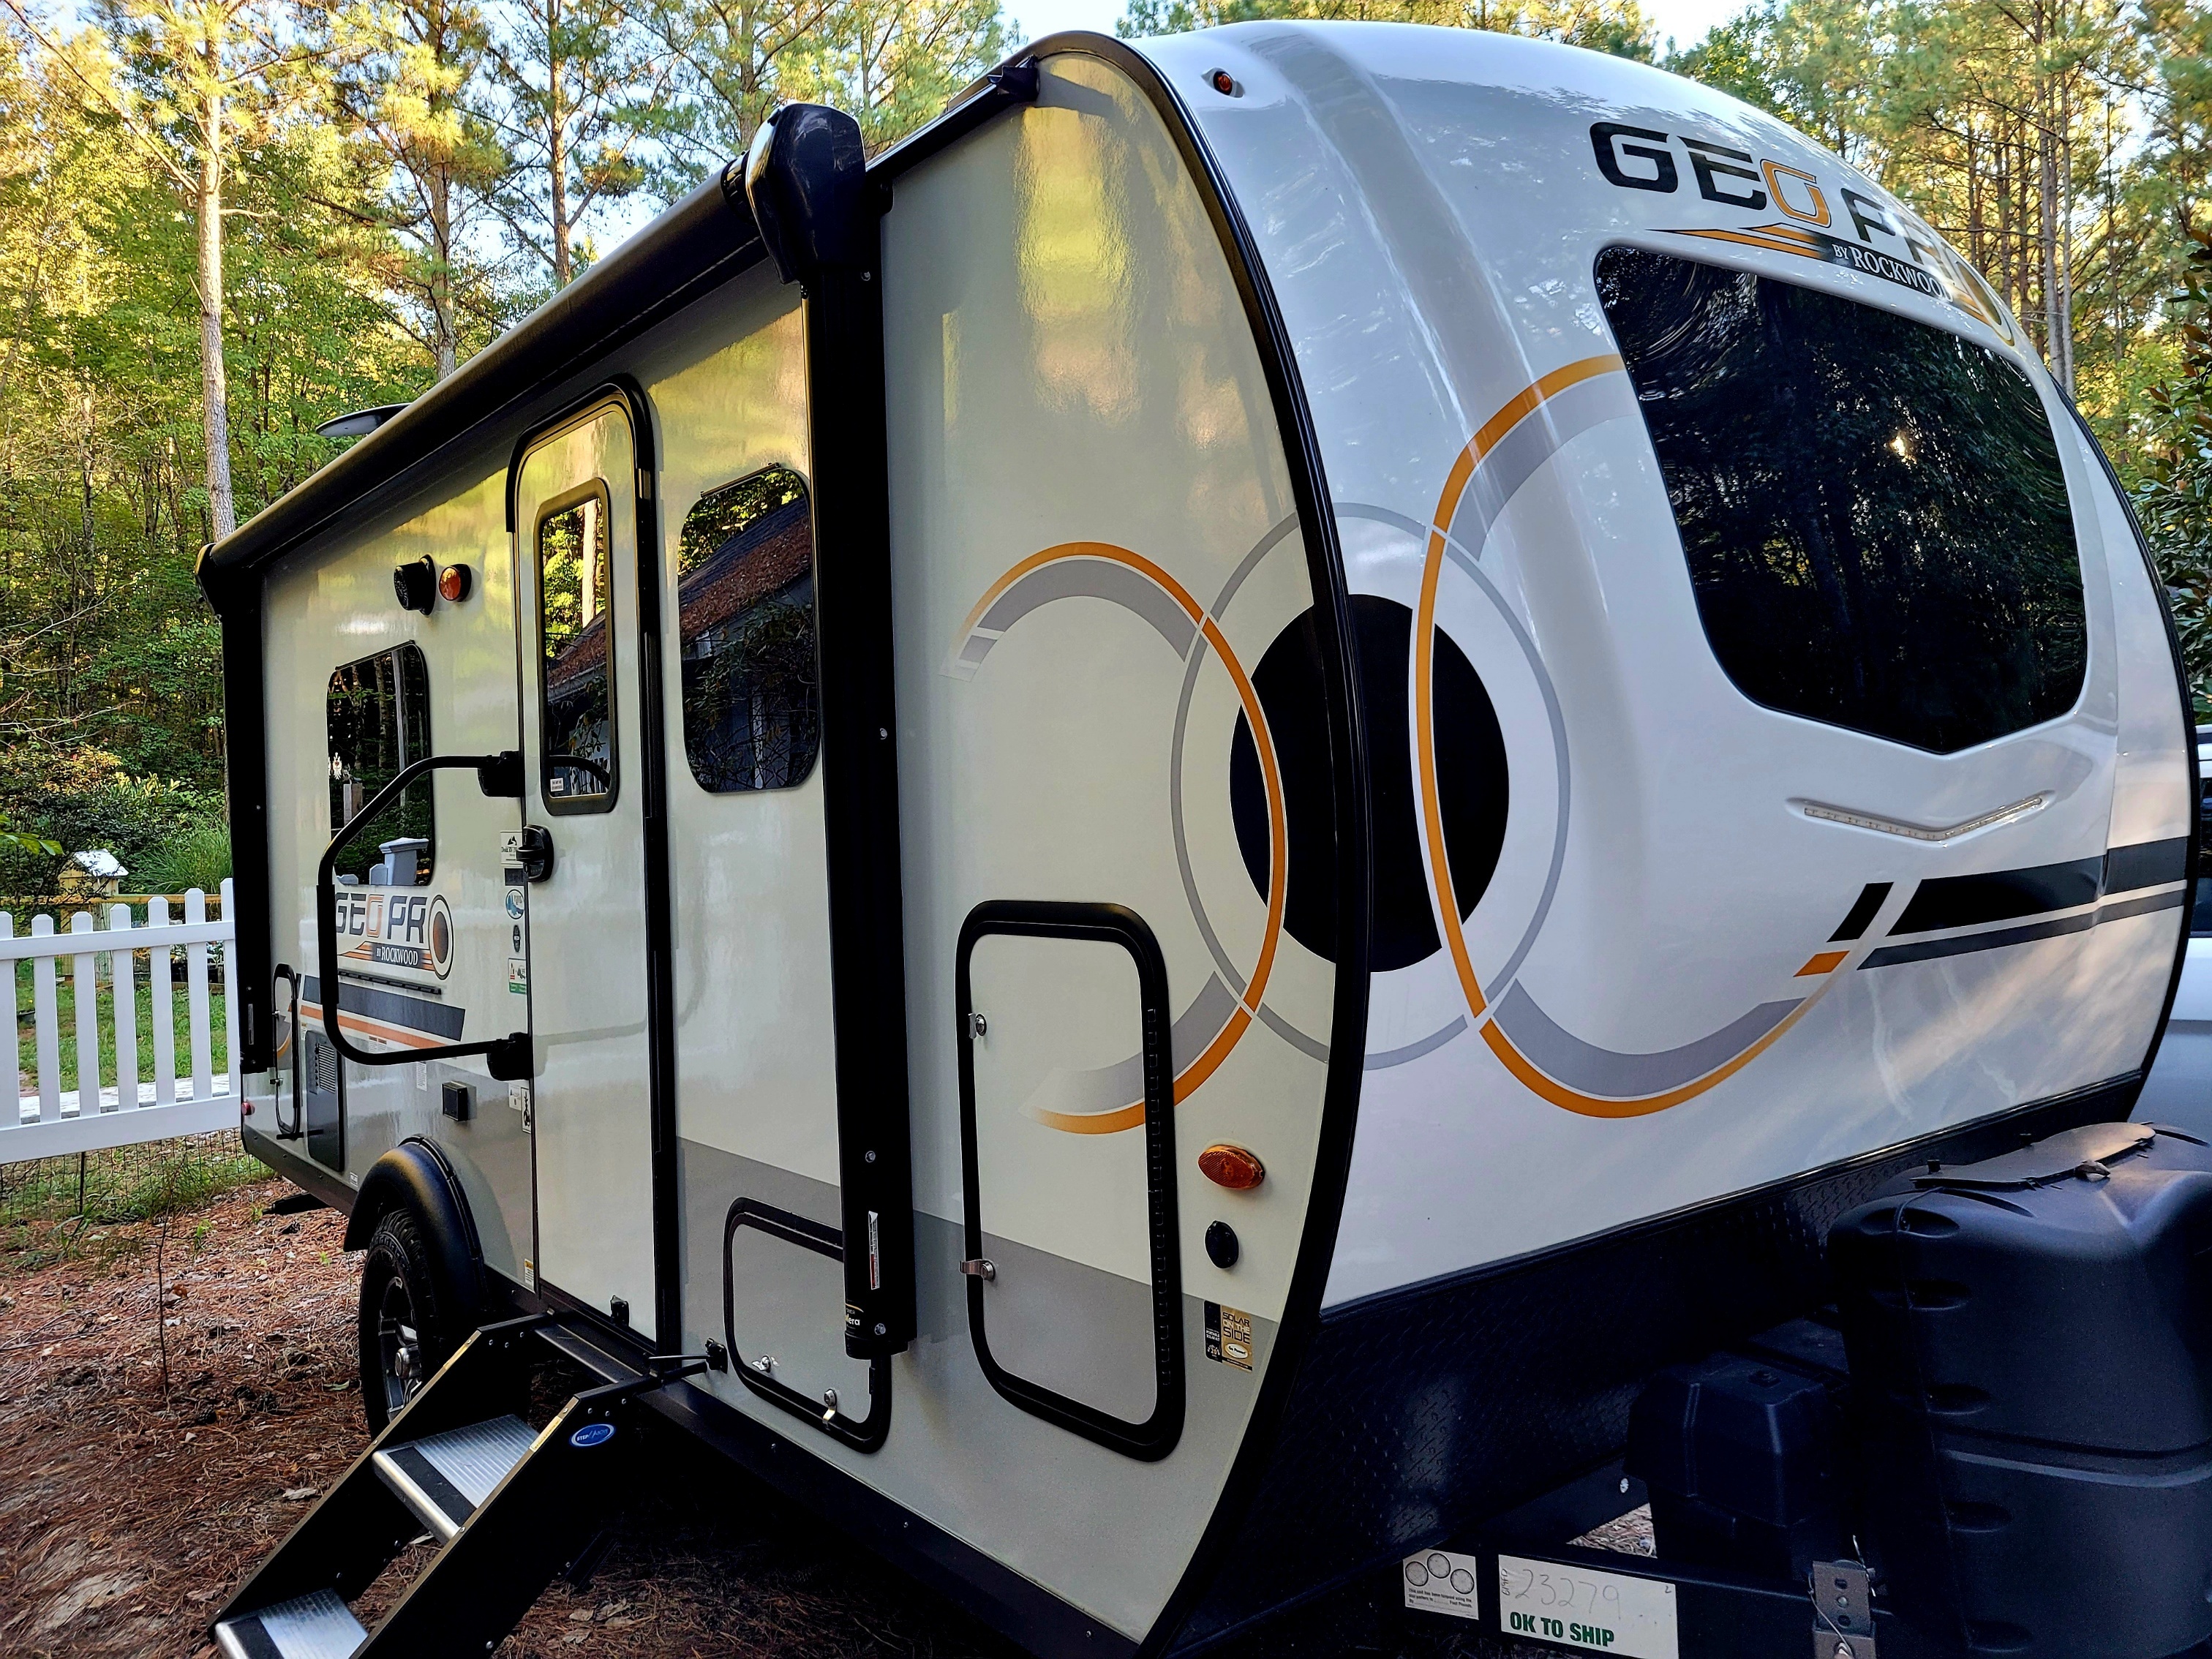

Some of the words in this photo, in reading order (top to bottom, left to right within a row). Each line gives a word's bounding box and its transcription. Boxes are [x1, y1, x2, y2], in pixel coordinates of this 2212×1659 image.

[1590, 121, 1831, 228] GEO
[1832, 244, 1848, 260] BY
[1848, 246, 1954, 303] ROCKWOOD
[376, 947, 381, 958] BY
[381, 947, 418, 966] ROCKWOOD
[1223, 1312, 1250, 1328] SOLAR
[1223, 1320, 1234, 1329] ON
[1235, 1323, 1250, 1333] THE
[1224, 1326, 1250, 1344] SIDE
[1515, 1568, 1621, 1620] 23279
[1510, 1611, 1536, 1634] OK
[1540, 1617, 1563, 1639] TO
[1570, 1624, 1614, 1647] SHIP
